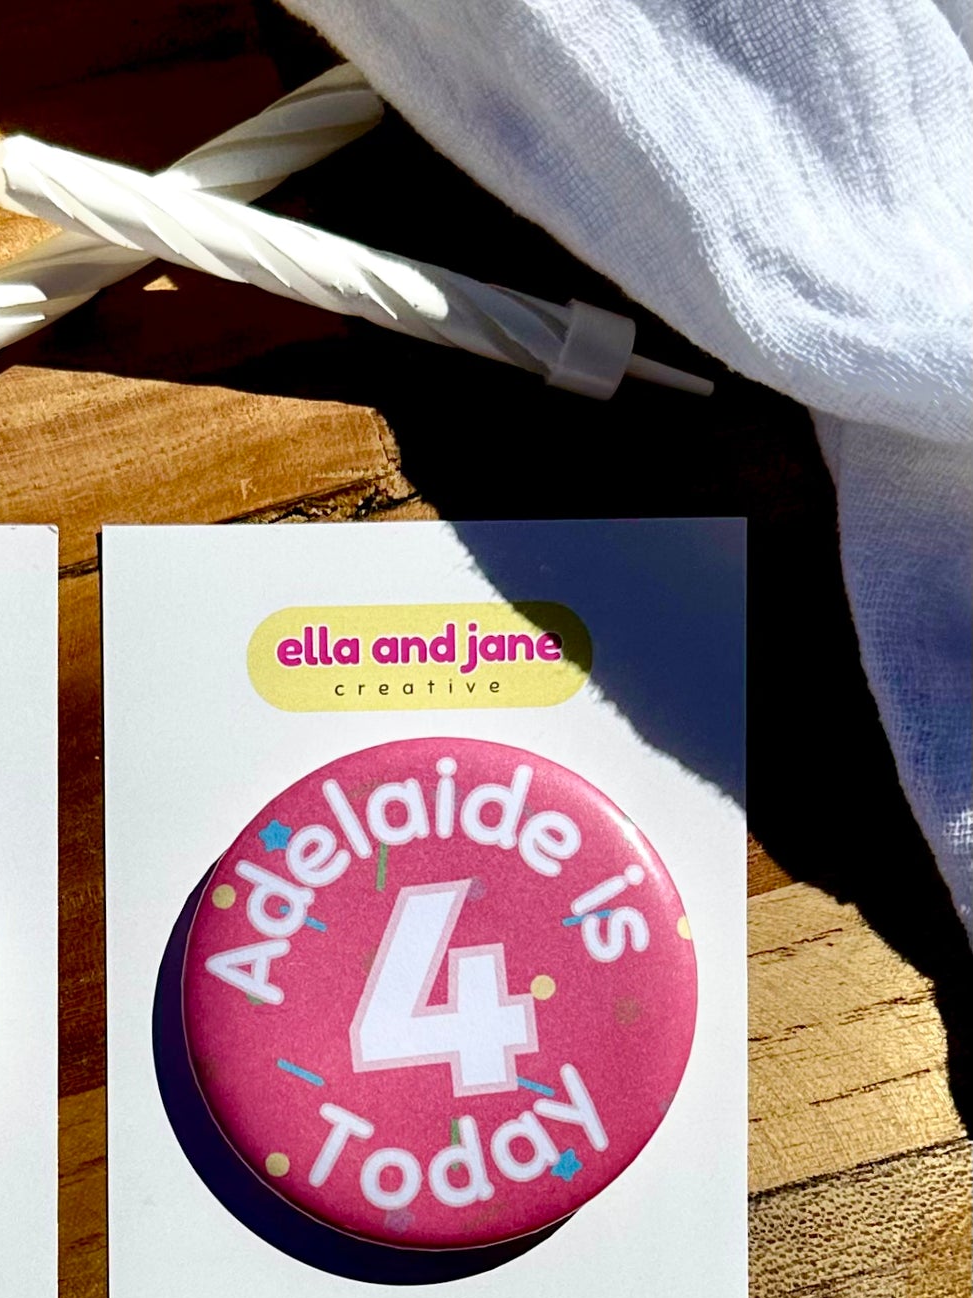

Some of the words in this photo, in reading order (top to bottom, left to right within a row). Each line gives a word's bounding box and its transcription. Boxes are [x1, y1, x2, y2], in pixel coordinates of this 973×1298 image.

[277, 626, 359, 666] ella
[371, 624, 455, 665] and
[461, 622, 562, 674] jane
[335, 677, 501, 697] creative
[205, 756, 581, 1005] Adelaide
[570, 864, 650, 962] is
[349, 877, 539, 1098] 4
[308, 1063, 609, 1210] Today
